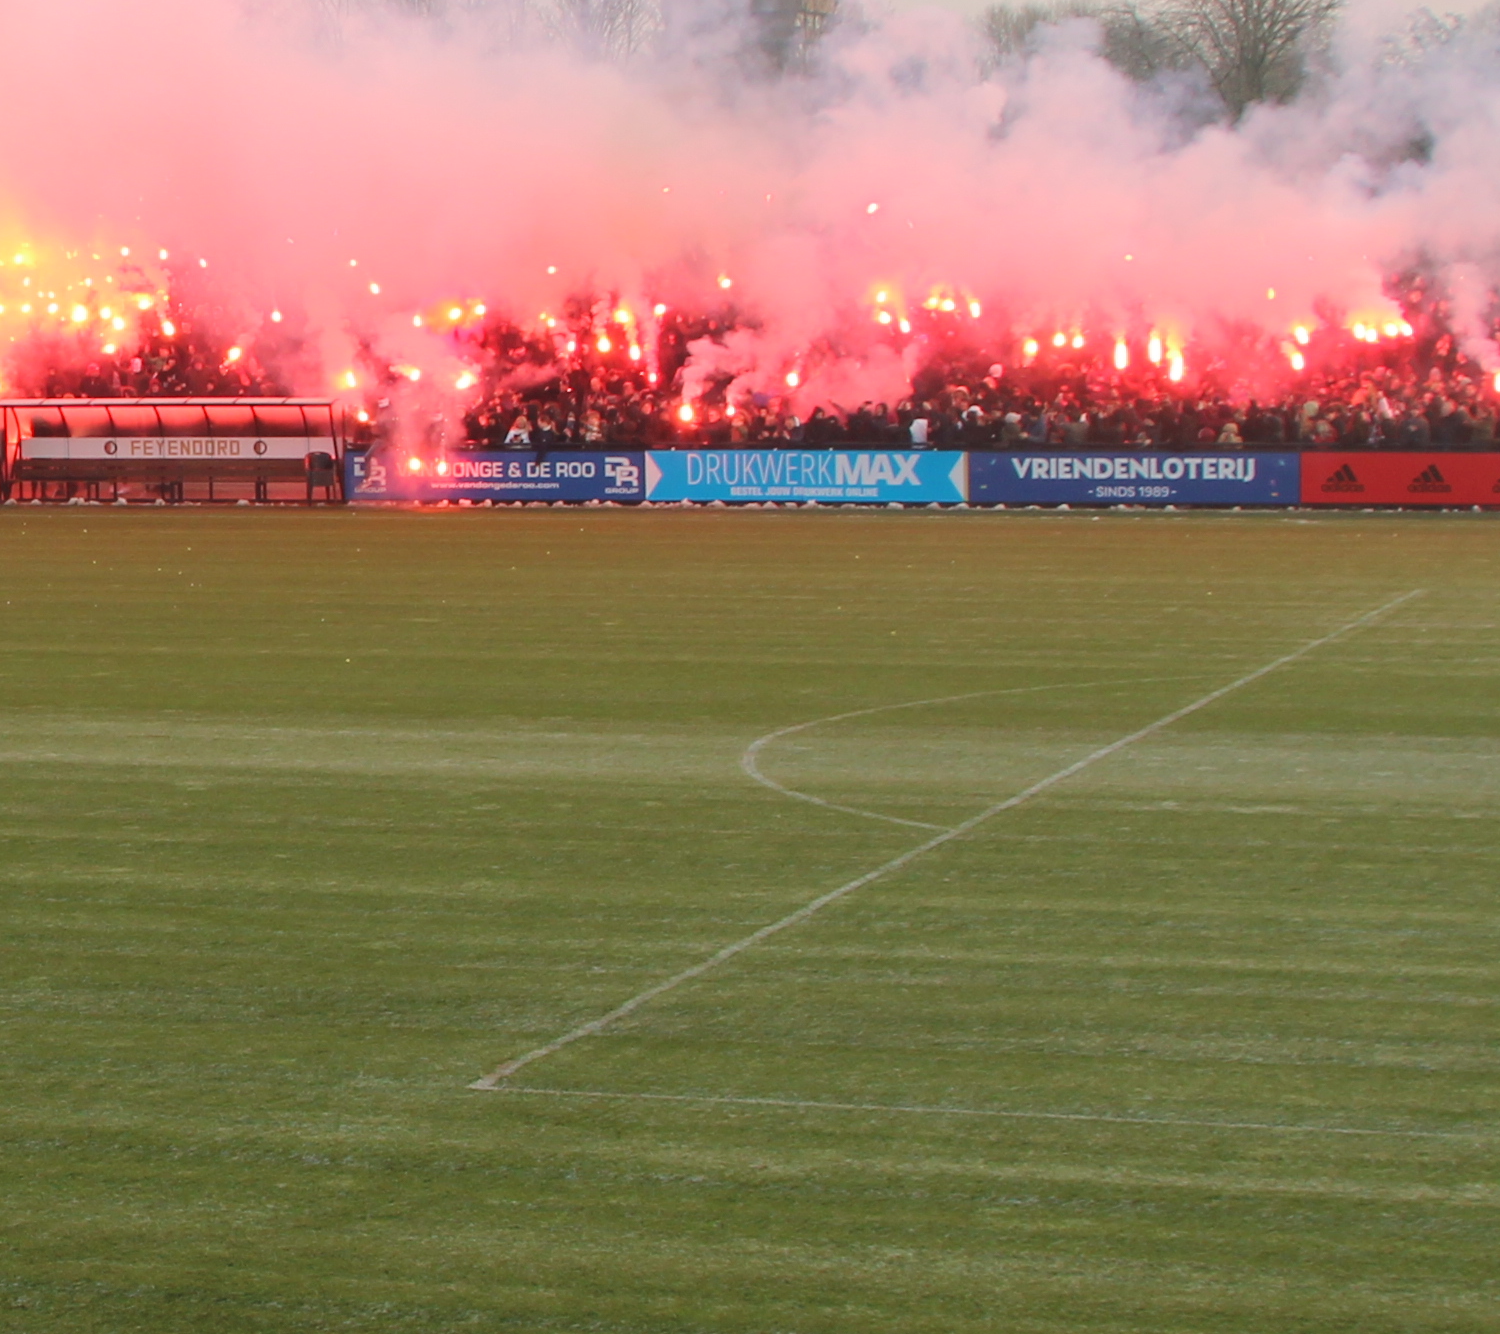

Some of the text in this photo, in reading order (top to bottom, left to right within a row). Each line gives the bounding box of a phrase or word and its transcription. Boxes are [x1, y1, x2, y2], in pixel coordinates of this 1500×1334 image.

[130, 440, 240, 456] FEYENOORD
[508, 462, 522, 478] &
[526, 462, 552, 478] DE
[556, 462, 596, 478] ROO
[686, 453, 922, 486] DRUKWERKMAX
[1011, 457, 1256, 482] VRIENDENLOTERIJ
[730, 486, 762, 496] BESTEL
[793, 487, 843, 497] DRUKWERK
[845, 487, 879, 497] ONLINE
